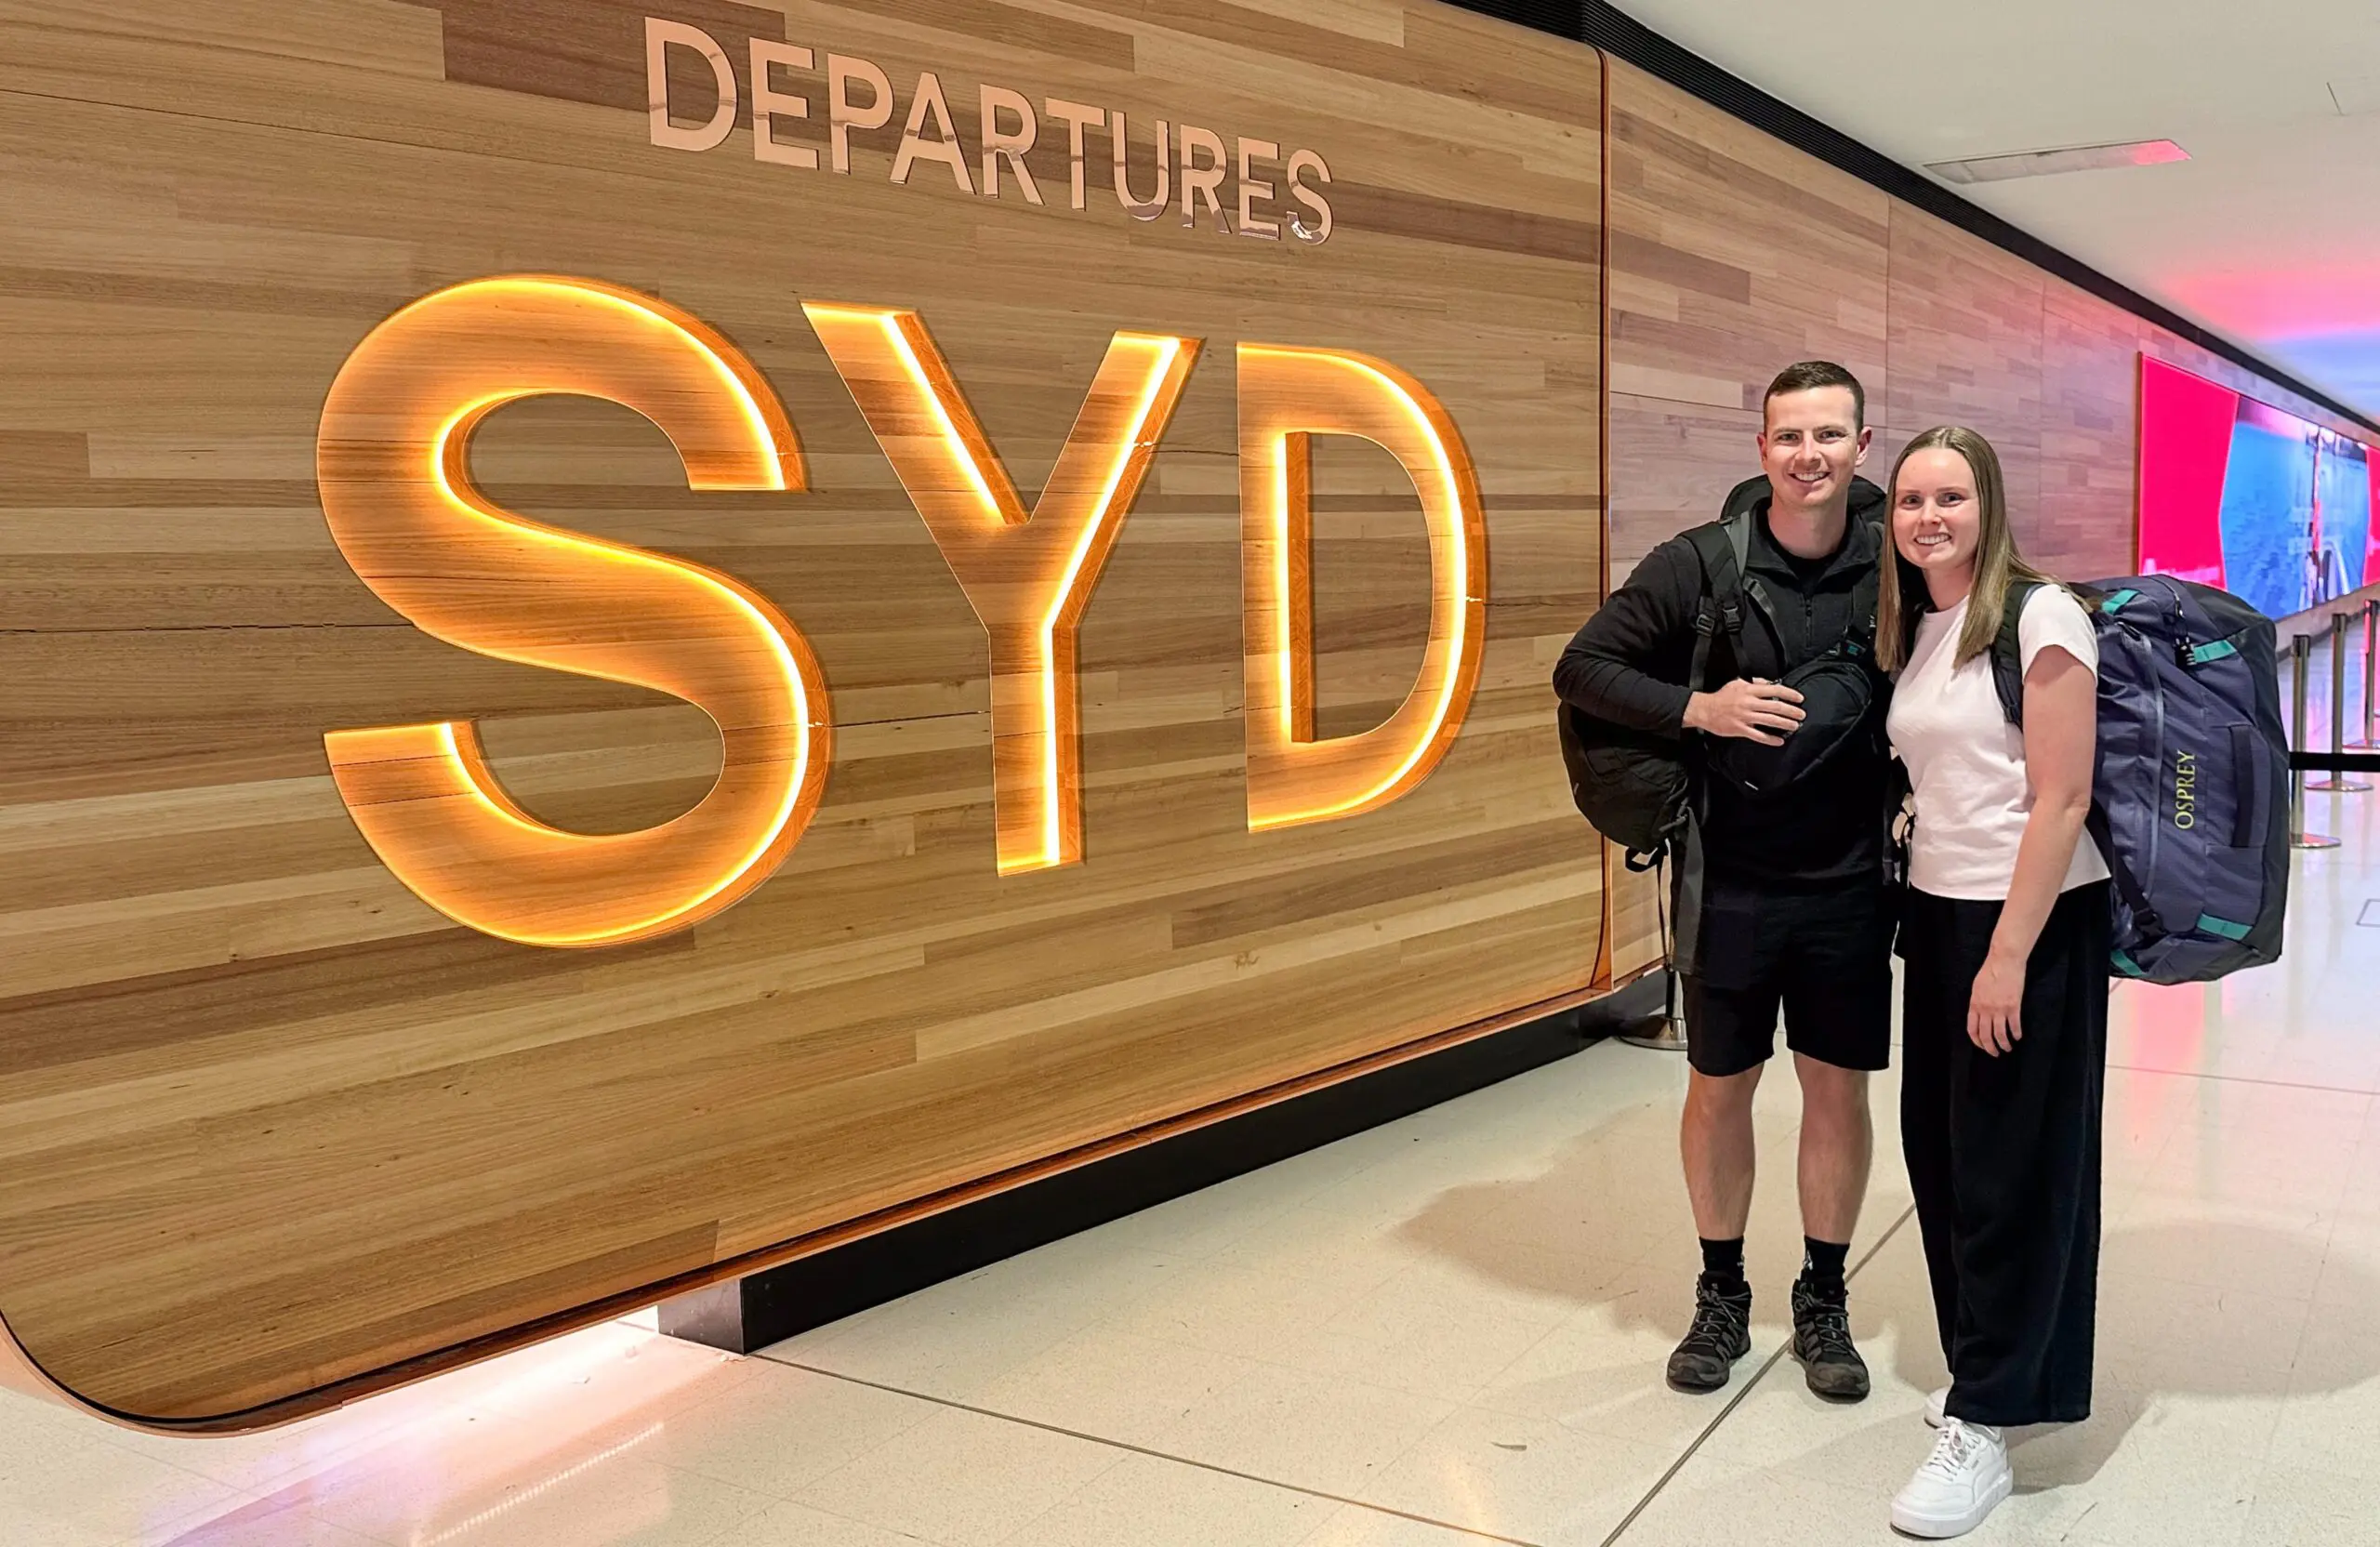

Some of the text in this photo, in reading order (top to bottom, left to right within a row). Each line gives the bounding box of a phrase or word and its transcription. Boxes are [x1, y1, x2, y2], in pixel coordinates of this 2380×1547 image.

[644, 16, 1333, 245] DEPARTURES
[316, 275, 1488, 947] SYD
[2175, 748, 2196, 829] OSPREY
